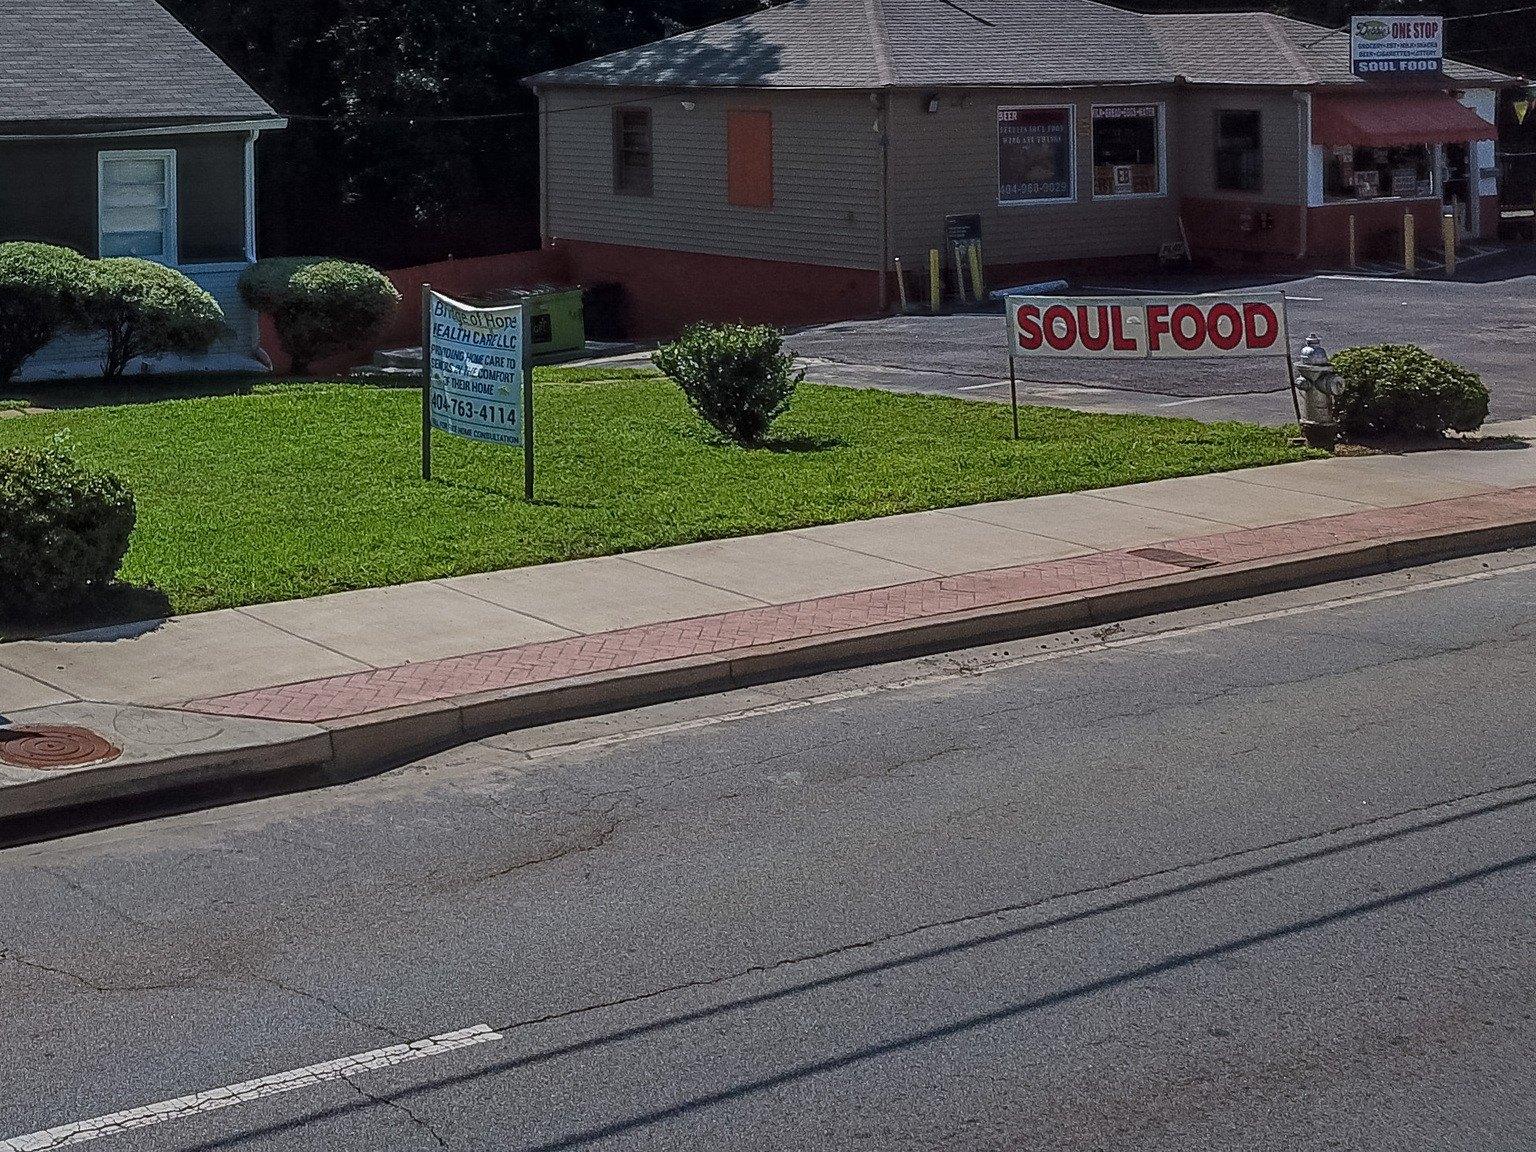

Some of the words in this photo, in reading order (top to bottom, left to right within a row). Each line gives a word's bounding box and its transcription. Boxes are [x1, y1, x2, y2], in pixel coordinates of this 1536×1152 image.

[1391, 22, 1411, 39] ONE
[1413, 22, 1438, 39] STOP
[1358, 61, 1396, 72] SOUL
[1399, 60, 1437, 71] FOOD
[469, 311, 484, 326] of
[484, 313, 517, 331] Hope
[1017, 304, 1137, 351] SOUL
[1146, 302, 1279, 351] FOOD
[473, 331, 497, 346] CARE
[497, 334, 517, 349] LLC
[485, 355, 505, 367] CARE
[506, 357, 516, 369] TO
[478, 368, 515, 383] COMFORT
[471, 383, 494, 395] HOME
